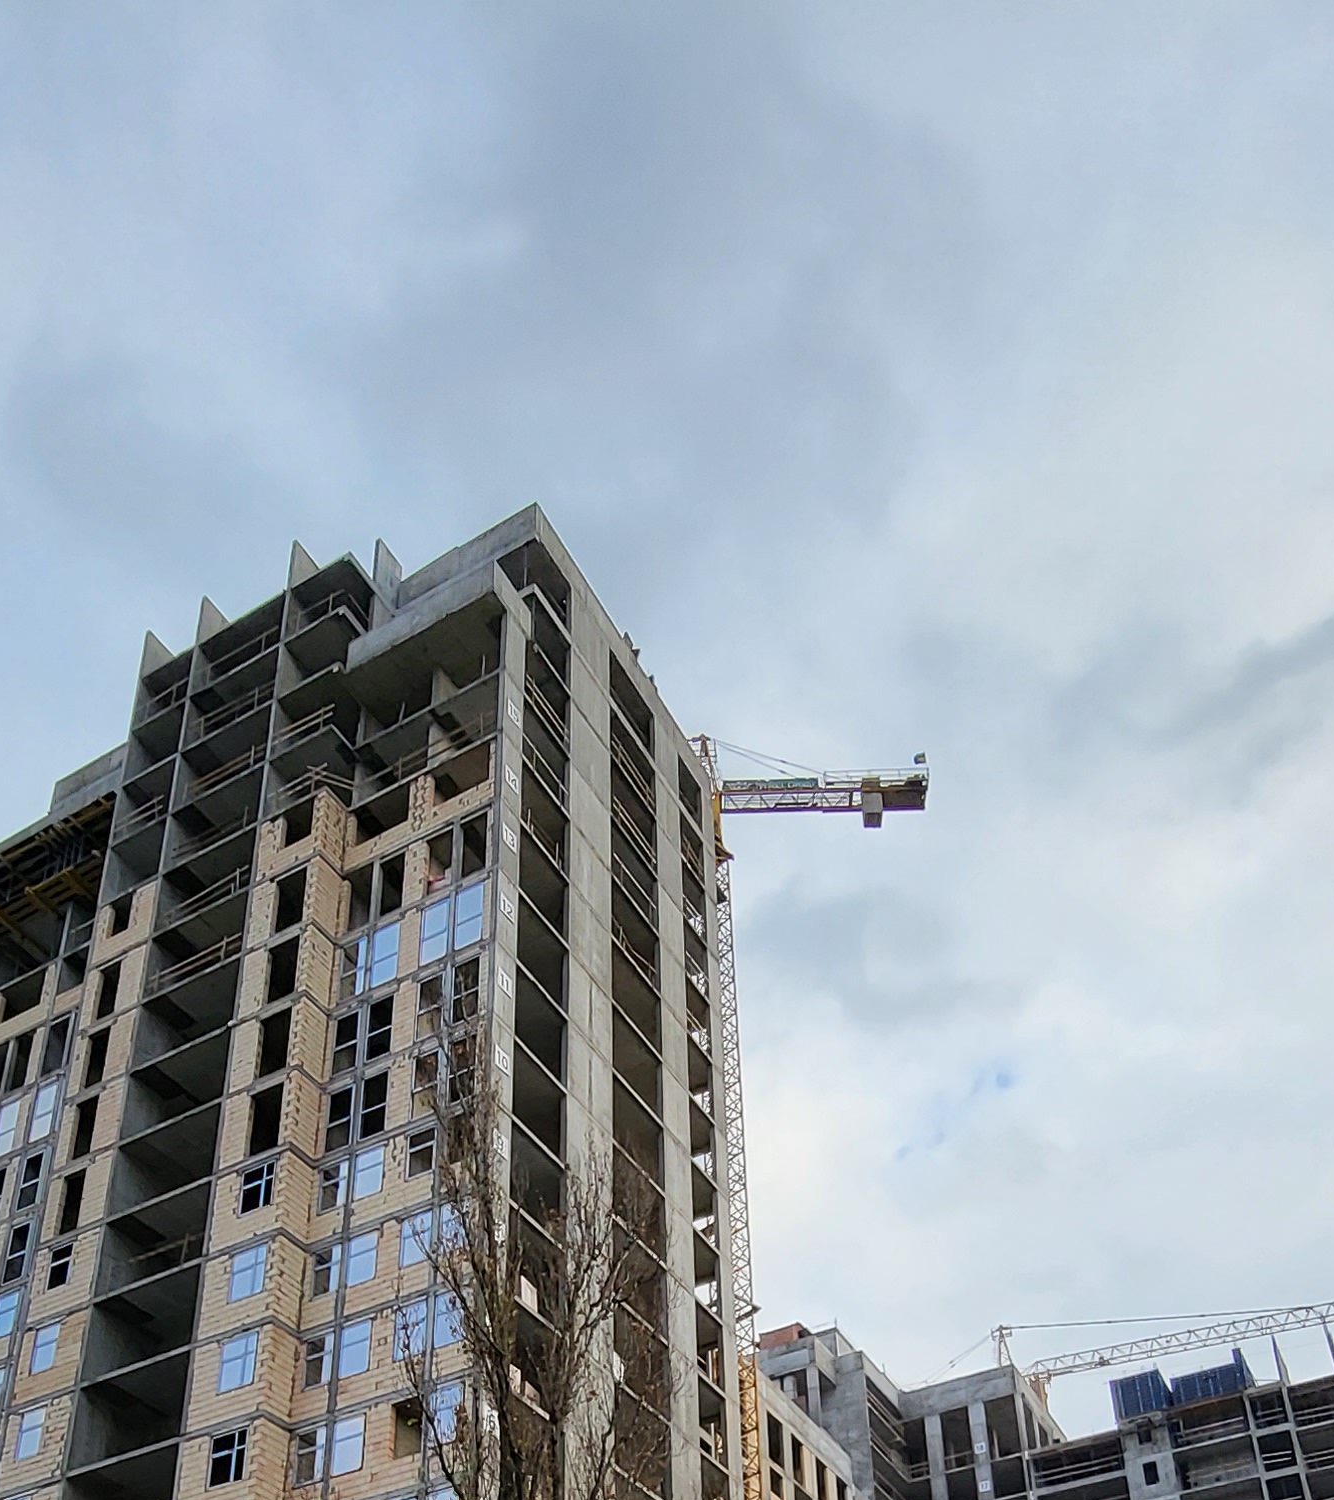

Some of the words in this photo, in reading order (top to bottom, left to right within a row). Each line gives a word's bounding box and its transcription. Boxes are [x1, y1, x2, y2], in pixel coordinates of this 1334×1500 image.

[504, 827, 515, 849] 13
[502, 898, 513, 917] 12
[500, 973, 509, 992] 11
[497, 1050, 508, 1070] 10
